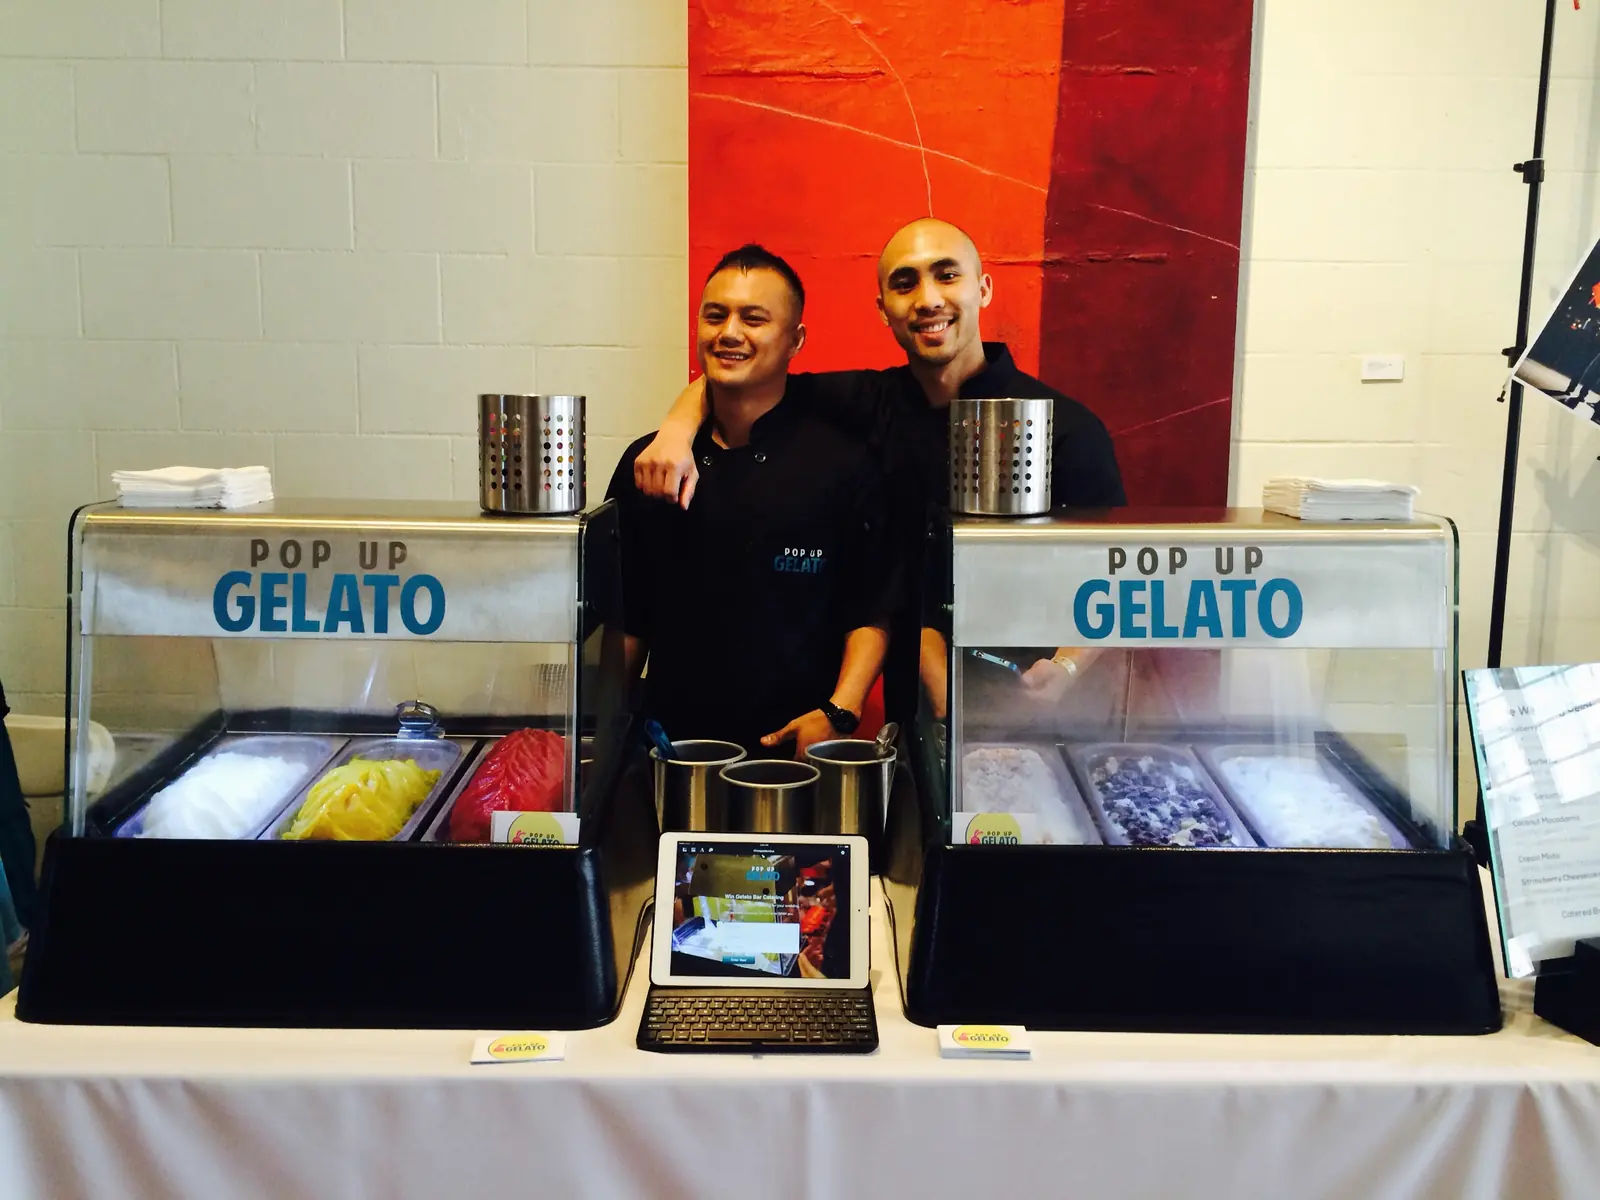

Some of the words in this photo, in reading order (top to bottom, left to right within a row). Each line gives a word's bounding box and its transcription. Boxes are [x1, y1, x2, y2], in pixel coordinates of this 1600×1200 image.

[250, 538, 331, 569] POP
[359, 541, 408, 570] UP
[784, 547, 806, 557] POP
[810, 549, 823, 558] UP
[1108, 547, 1188, 575] POP
[1215, 546, 1263, 575] UP
[212, 570, 446, 635] GELATO
[1073, 577, 1304, 640] GELATO
[981, 836, 1018, 844] GELATO
[505, 1044, 546, 1052] GELATO
